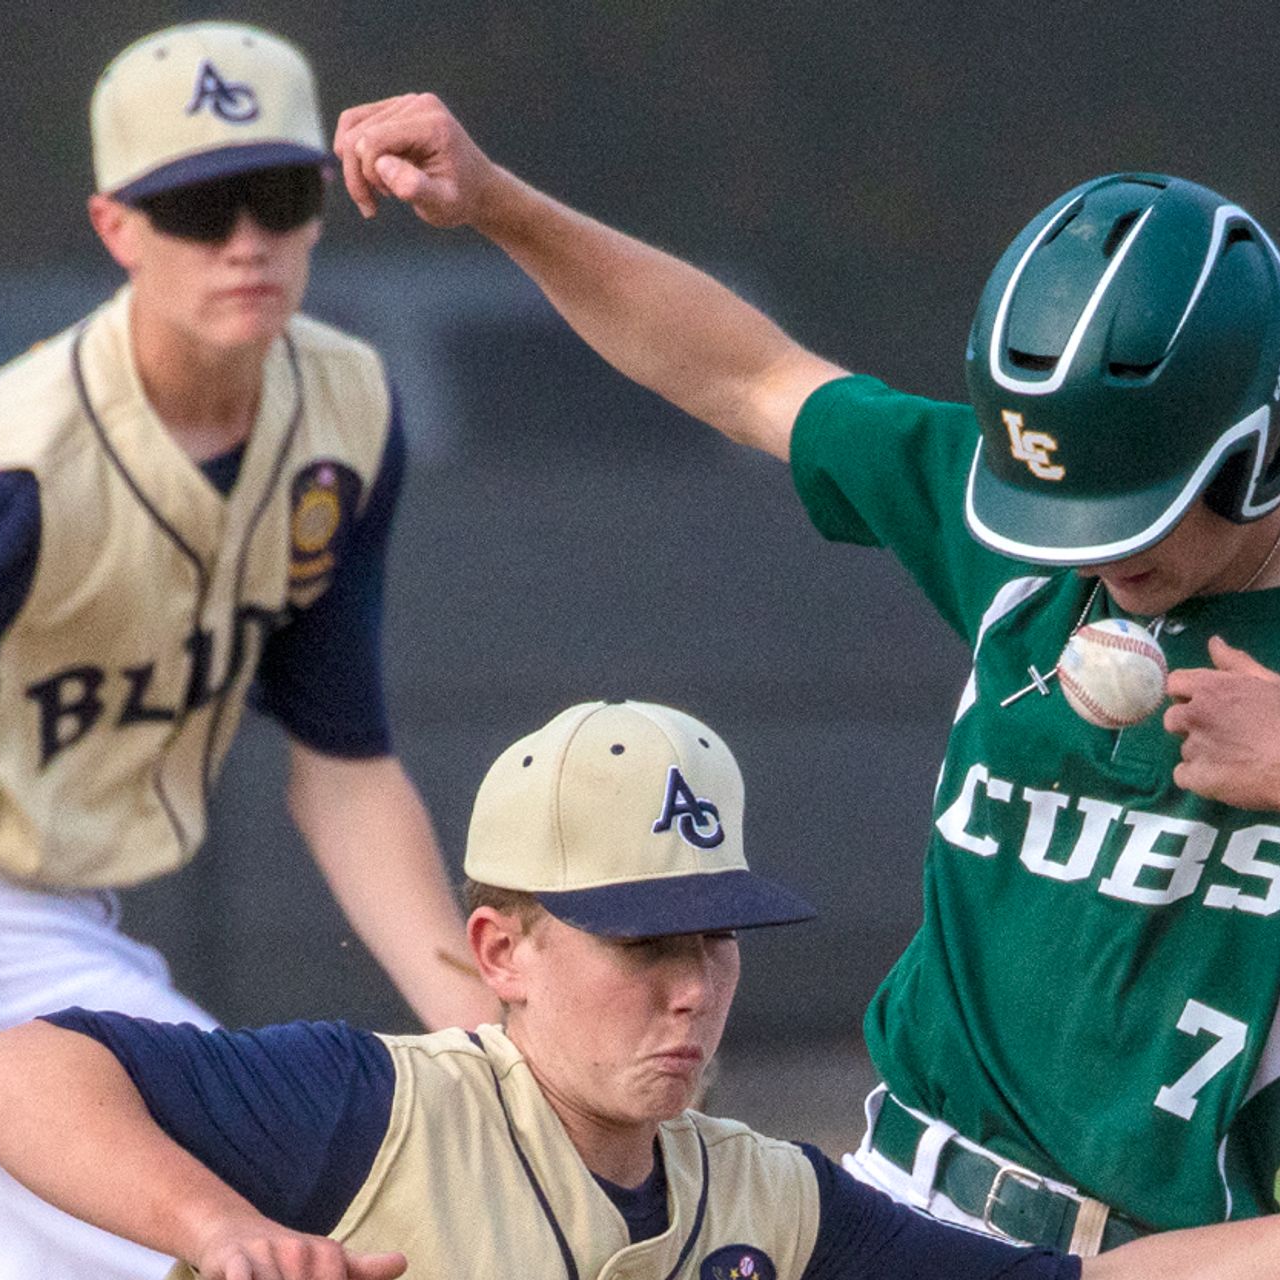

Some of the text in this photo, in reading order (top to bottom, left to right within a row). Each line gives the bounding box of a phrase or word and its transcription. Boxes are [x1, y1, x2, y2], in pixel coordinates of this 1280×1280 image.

[1001, 408, 1066, 482] LC
[25, 604, 292, 772] BLU
[1154, 999, 1248, 1121] 7
